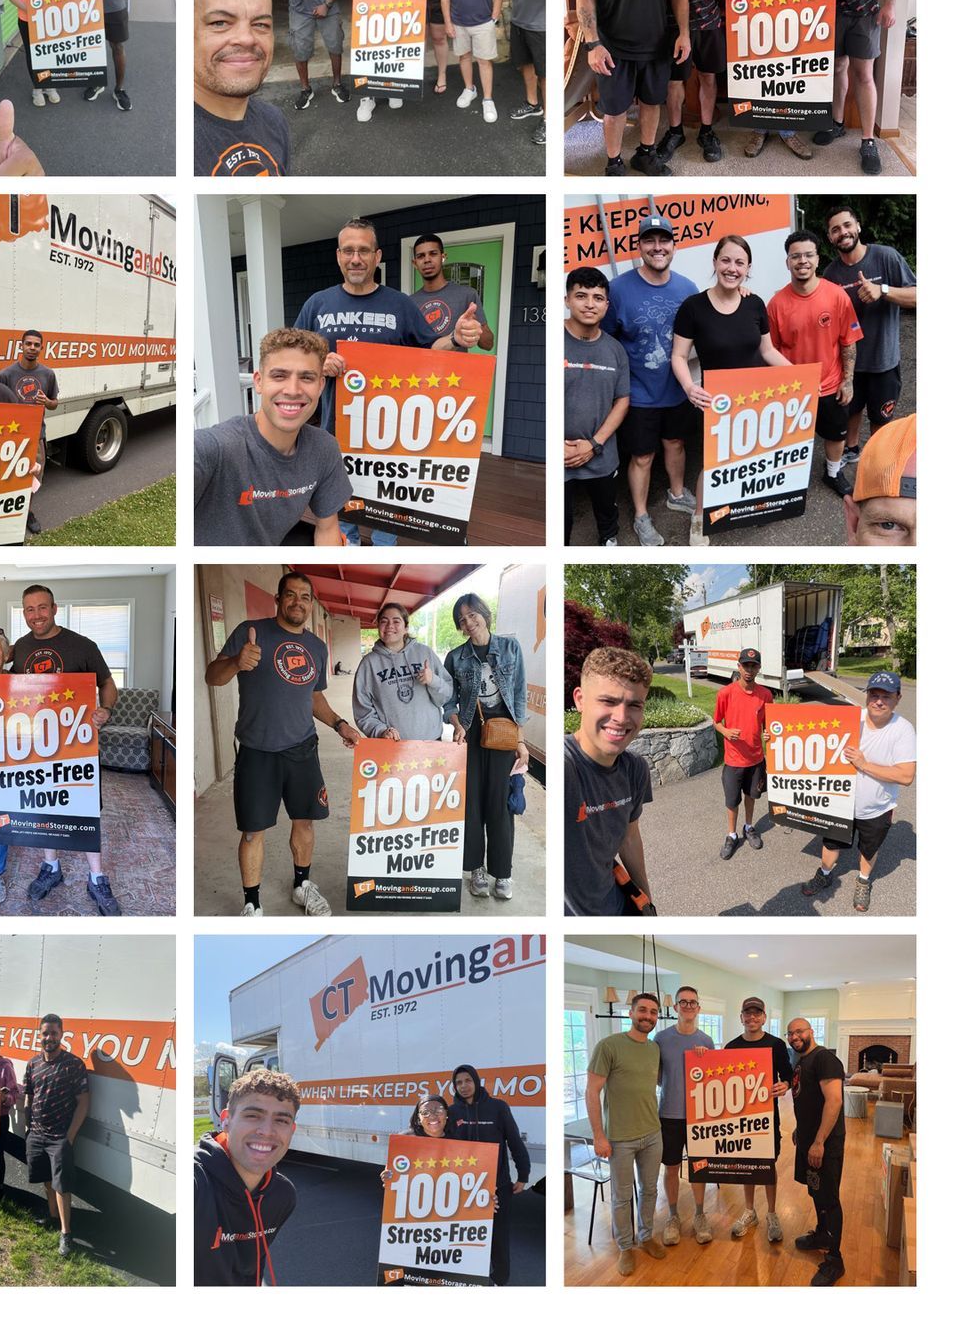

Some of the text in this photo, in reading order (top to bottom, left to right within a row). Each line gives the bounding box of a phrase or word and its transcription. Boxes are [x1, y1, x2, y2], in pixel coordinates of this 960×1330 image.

[356, 10, 421, 44] 100%
[731, 5, 829, 57] 100%
[35, 33, 101, 56] Stress-Free
[355, 46, 420, 61] Stress-Free
[56, 51, 86, 66] Move
[374, 61, 404, 74] Move
[732, 57, 829, 80] Stress-Free
[761, 79, 805, 97] Move
[656, 200, 695, 219] YOU
[50, 204, 176, 283] MovingandSt
[49, 250, 95, 272] EST. 1972
[317, 311, 397, 330] YANKEES
[45, 341, 97, 360] KEEPS
[101, 343, 126, 358] YOU
[343, 393, 477, 451] 100%
[711, 393, 812, 461] 100%
[345, 453, 470, 482] Stress-Free
[711, 445, 808, 487] Stress-Free
[377, 480, 434, 503] Move
[741, 471, 785, 498] Move
[770, 732, 850, 771] 100%
[771, 774, 851, 792] Stress-Free
[20, 789, 69, 809] Move
[358, 771, 460, 827] 100%
[793, 792, 829, 807] Move
[356, 827, 458, 854] Stress-Free
[386, 852, 434, 874] Move
[321, 978, 354, 1020] CT
[370, 1001, 417, 1021] EST. 1972
[82, 1033, 150, 1067] YOU
[300, 1080, 429, 1099] WHEN LIFE KEEPS
[690, 1071, 768, 1119] 100%
[691, 1117, 769, 1140] Stress-Free
[715, 1137, 751, 1154] Move
[390, 1171, 489, 1218] 100%
[387, 1223, 487, 1244] Stress-Free
[415, 1246, 461, 1266] Move
